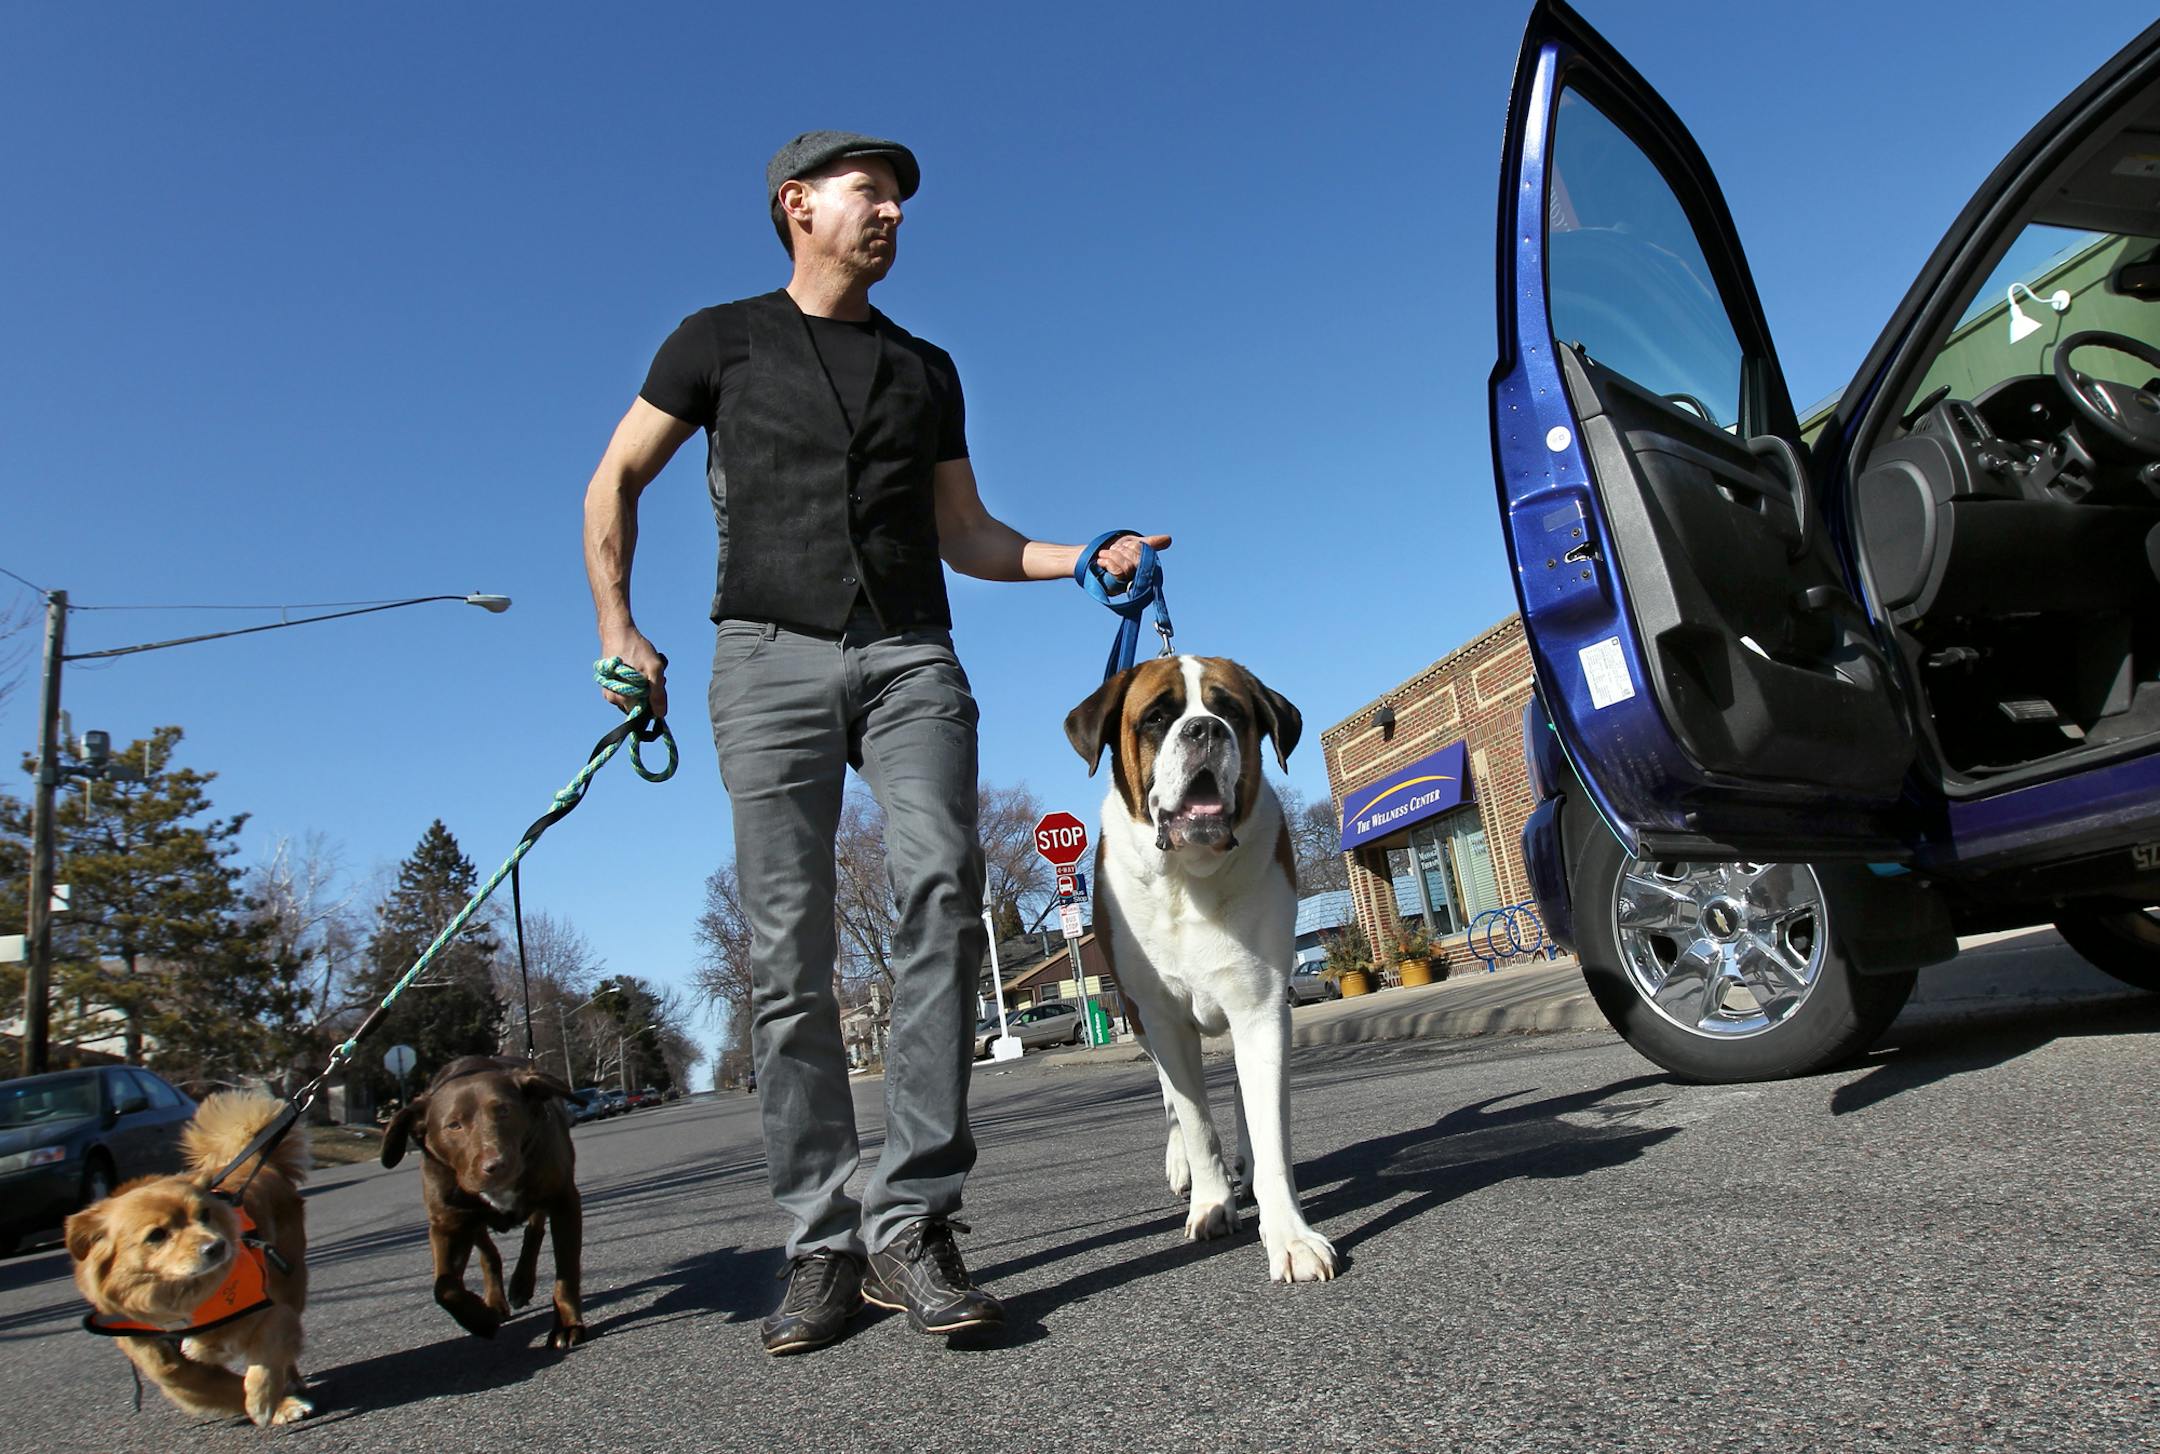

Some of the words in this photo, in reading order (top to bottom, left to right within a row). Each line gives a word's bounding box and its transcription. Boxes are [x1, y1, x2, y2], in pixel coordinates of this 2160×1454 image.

[1371, 804, 1408, 828] WELLNESS
[1409, 789, 1440, 811] CENTER
[1038, 826, 1083, 850] STOP
